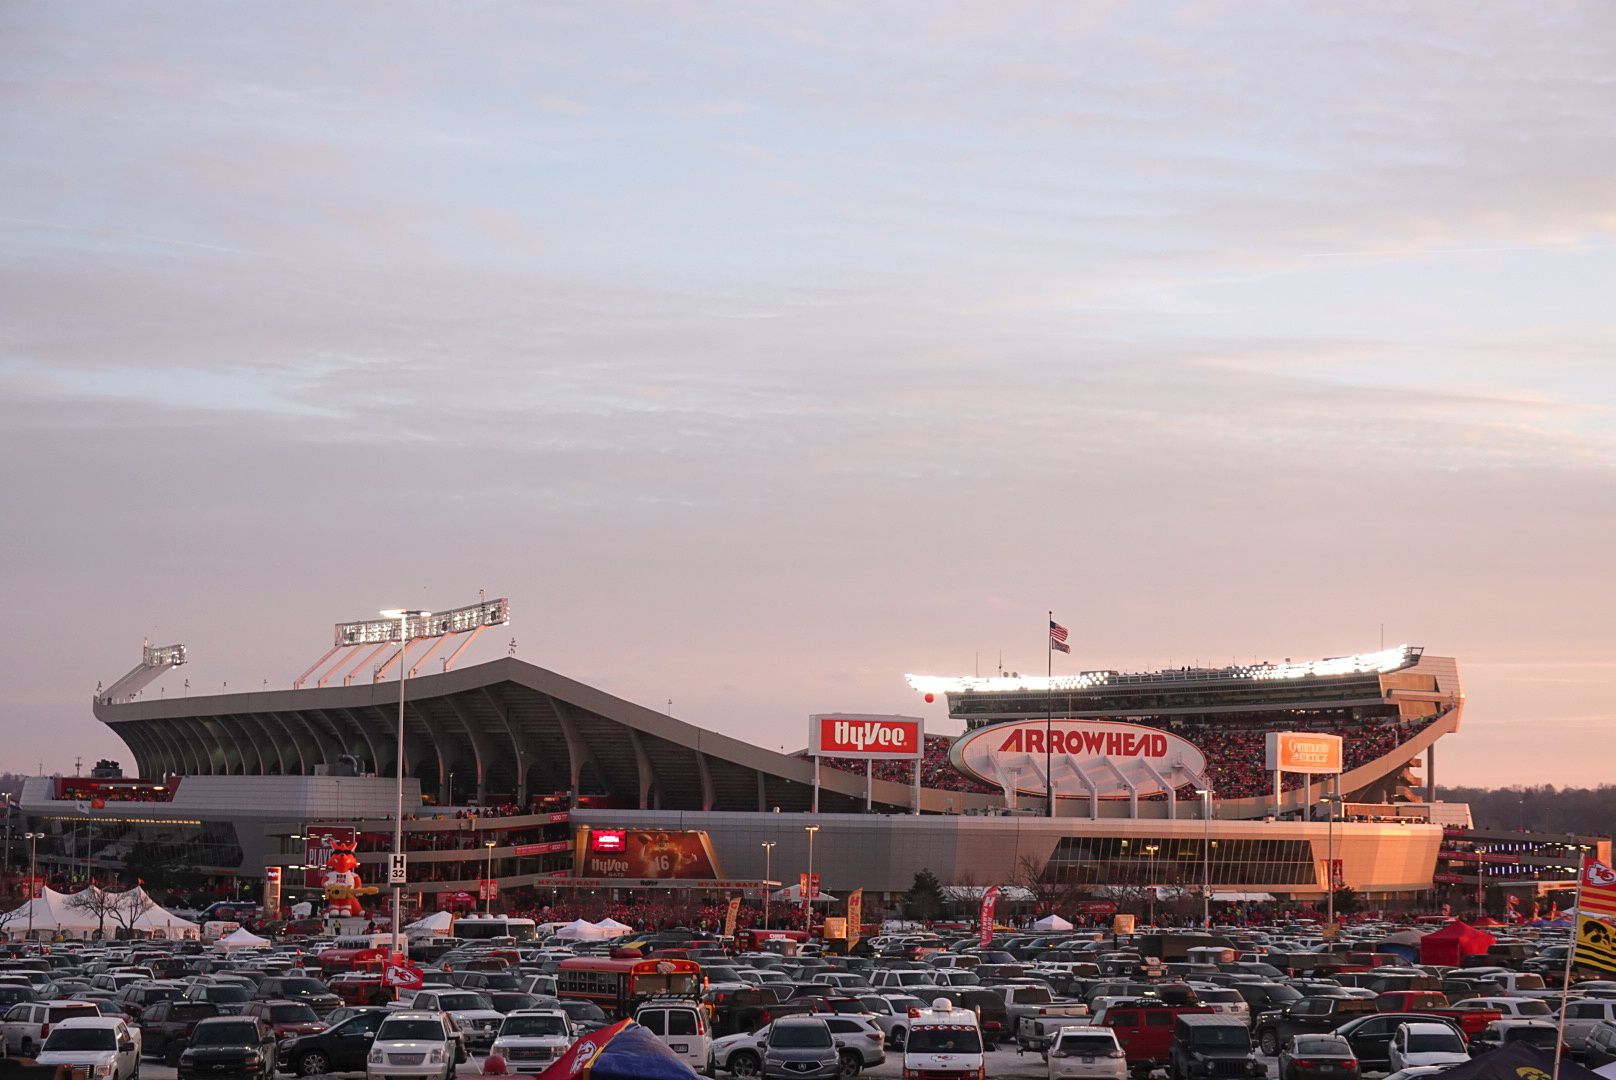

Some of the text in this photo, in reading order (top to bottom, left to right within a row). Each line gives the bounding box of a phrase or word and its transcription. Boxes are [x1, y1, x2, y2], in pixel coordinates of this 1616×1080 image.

[998, 729, 1168, 757] ARROWHEAD
[393, 855, 405, 868] H
[655, 855, 670, 871] 16
[392, 869, 405, 878] 32
